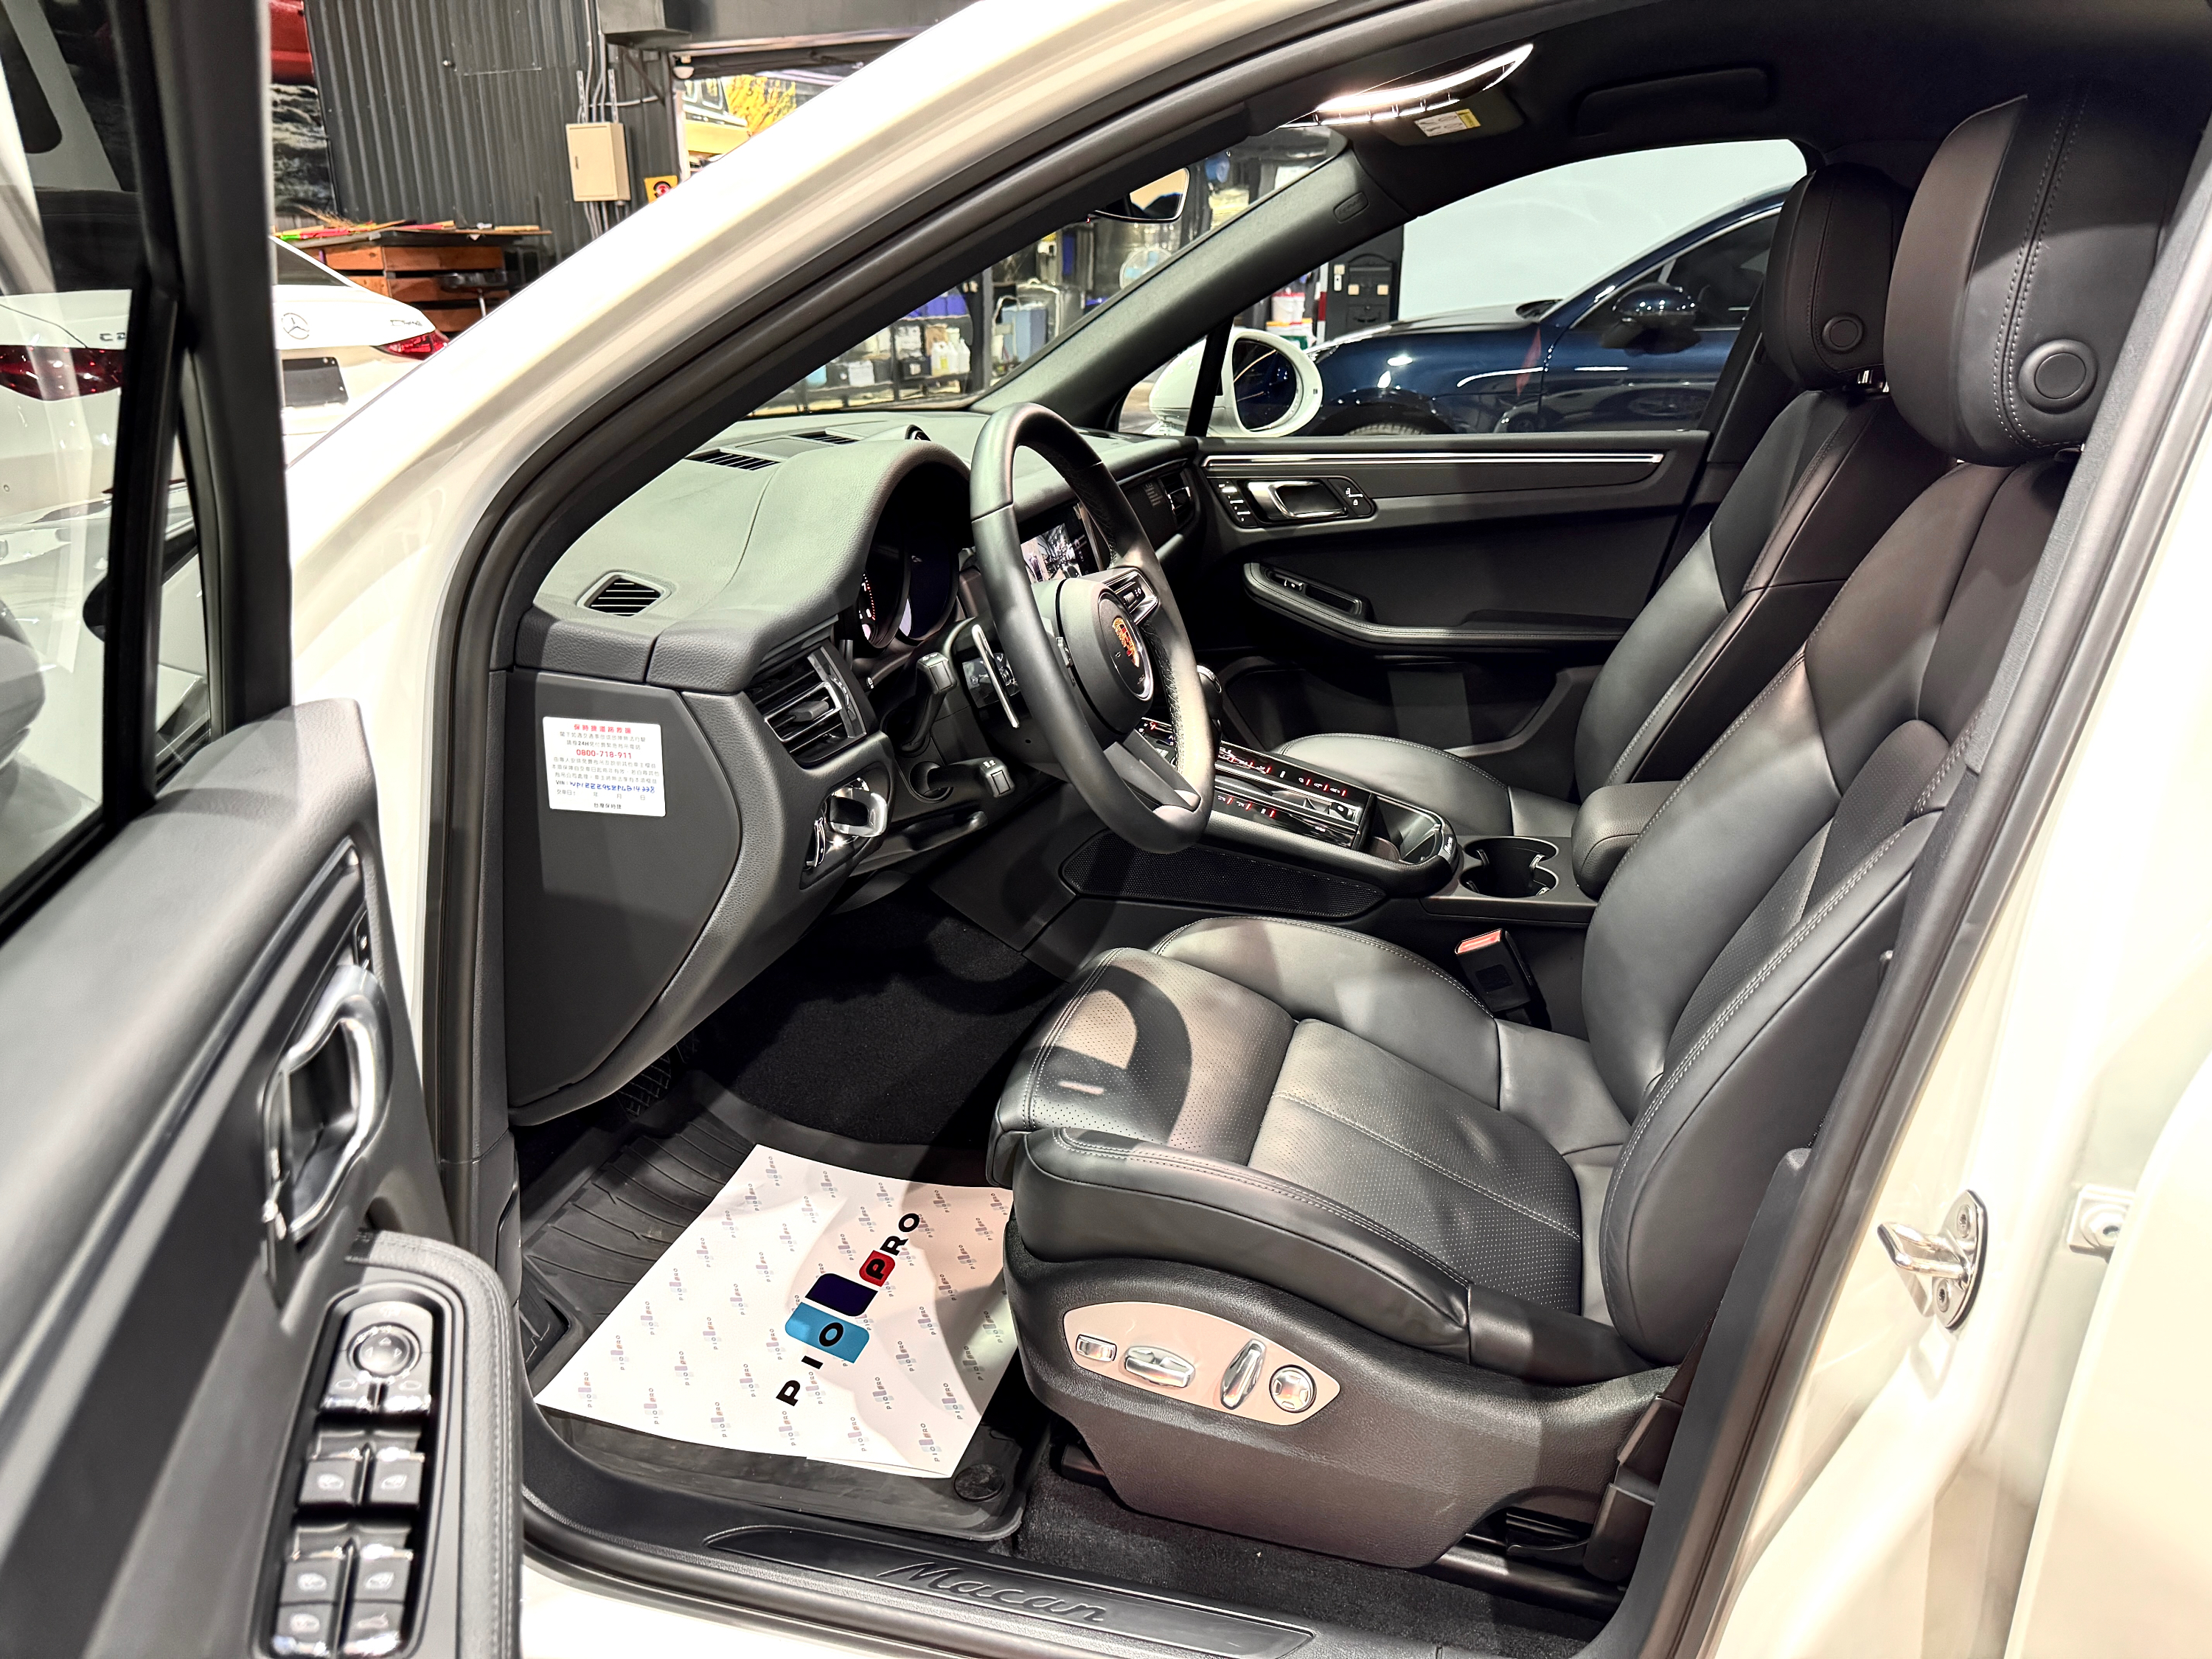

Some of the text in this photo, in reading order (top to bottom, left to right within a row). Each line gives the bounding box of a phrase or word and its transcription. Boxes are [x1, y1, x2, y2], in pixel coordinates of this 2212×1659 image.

[574, 724, 631, 734] 保時捷道路救援
[577, 749, 631, 759] 0800-718-911
[776, 1212, 920, 1407] PIO PRO
[877, 1562, 1106, 1621] Macan
